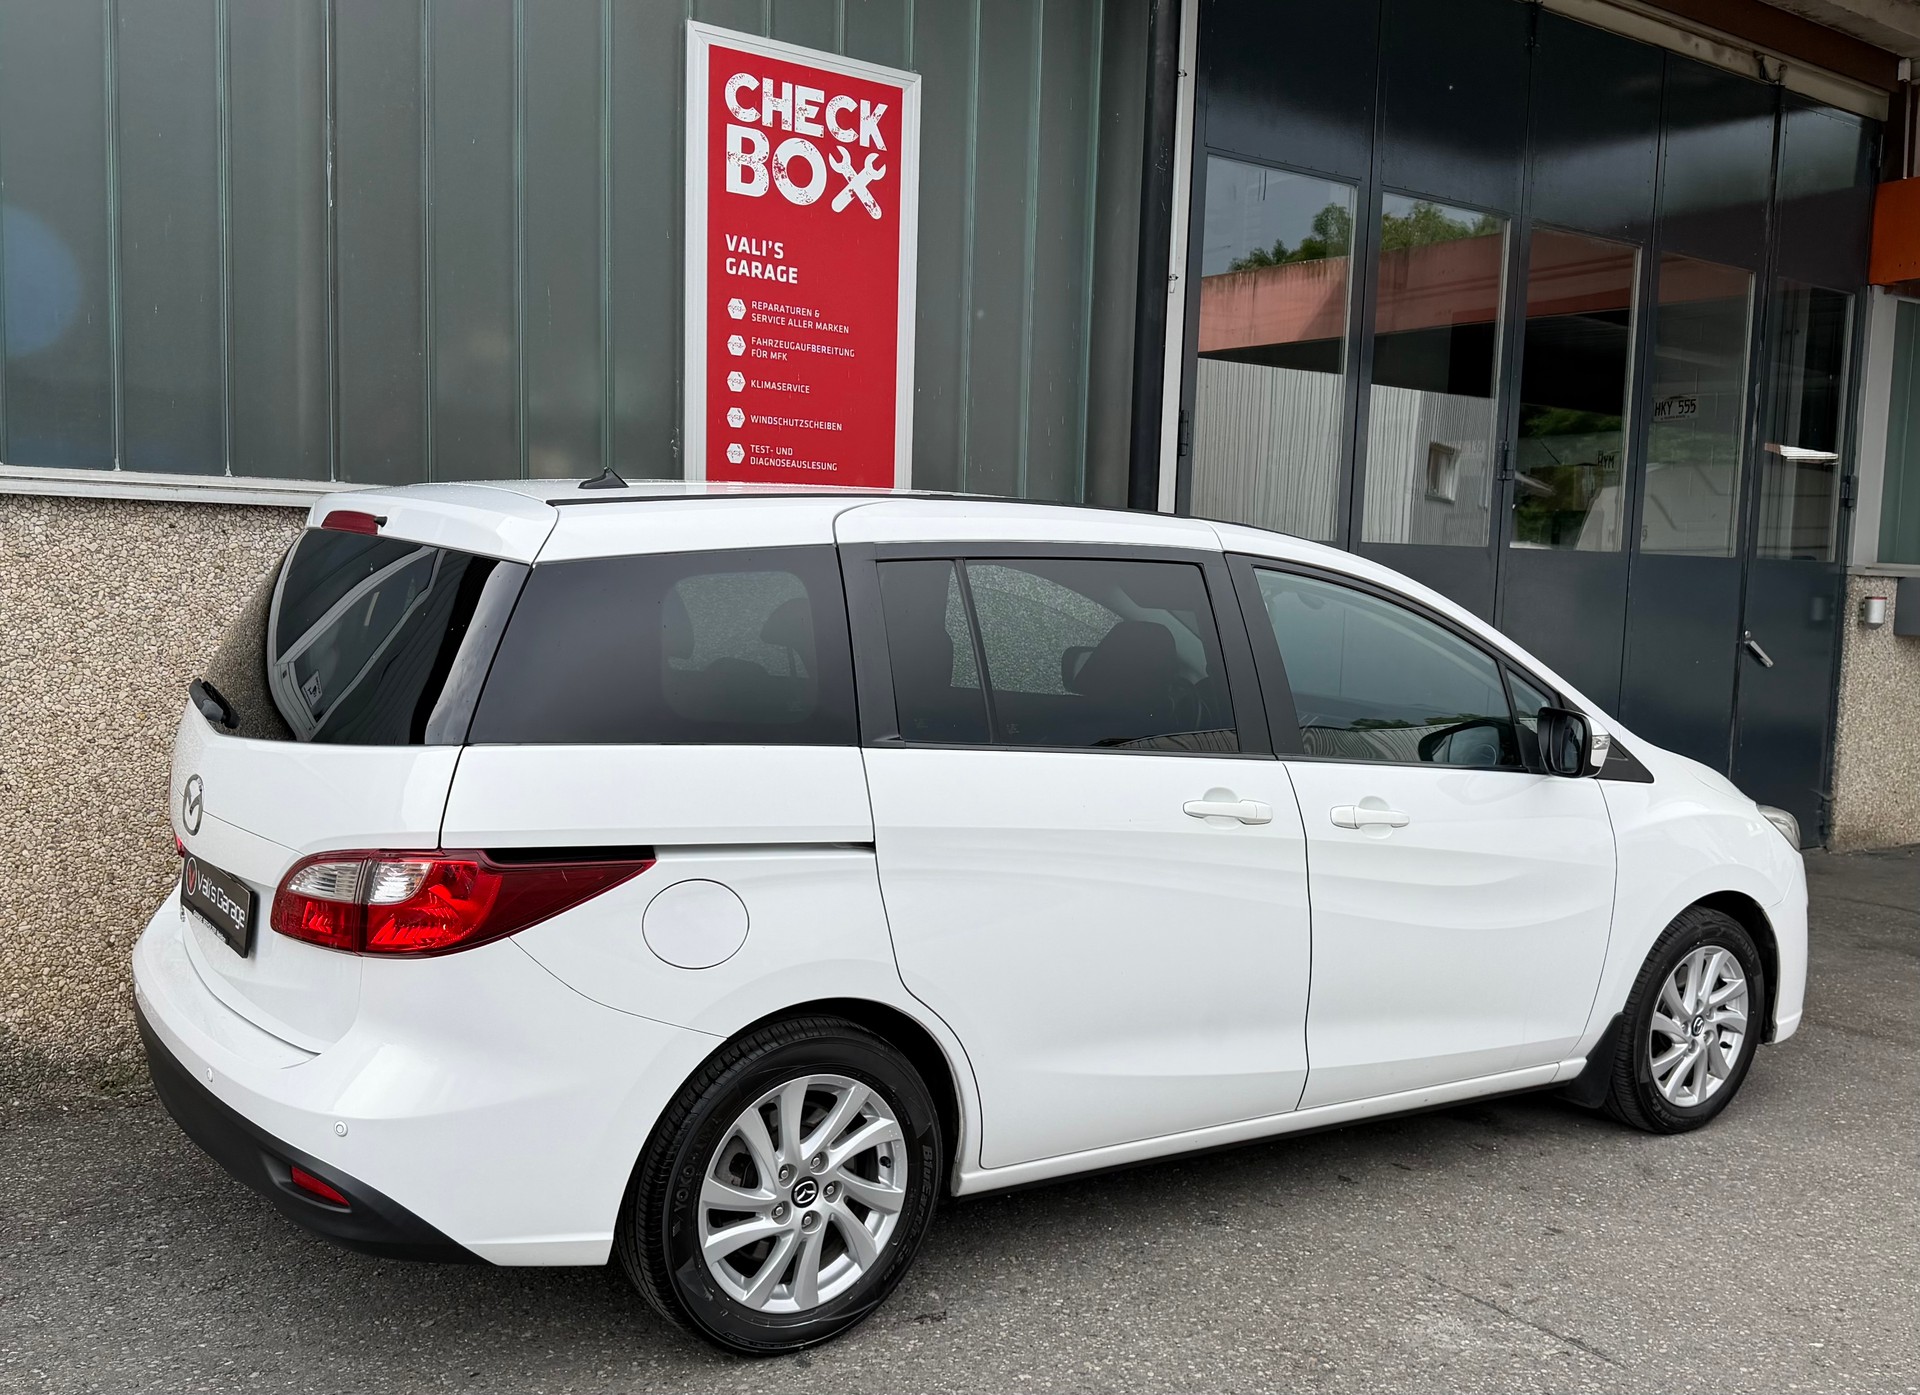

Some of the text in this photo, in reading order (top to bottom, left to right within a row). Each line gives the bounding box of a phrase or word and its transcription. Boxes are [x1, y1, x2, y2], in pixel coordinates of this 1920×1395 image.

[725, 73, 888, 151] CHECK
[726, 124, 886, 219] BOX
[726, 234, 783, 259] VALI'S
[726, 258, 797, 284] GARAGE
[752, 301, 812, 316] REPARATUREN
[752, 313, 849, 333] SERVICE ALLER MARKEN
[752, 337, 854, 357] FAHRZEUGAUFBEREITUNG
[752, 349, 787, 360] FÜR MFK
[751, 380, 809, 393] KLIMASERVICE
[1654, 398, 1697, 417] HKY 555
[751, 415, 842, 430] WINDSCHUTZSCHEIBEN
[750, 445, 792, 455] TEST- UND
[751, 457, 837, 470] DIAGNOSEAUSLESUNG
[198, 869, 216, 903] Vali's
[216, 887, 246, 930] Garage
